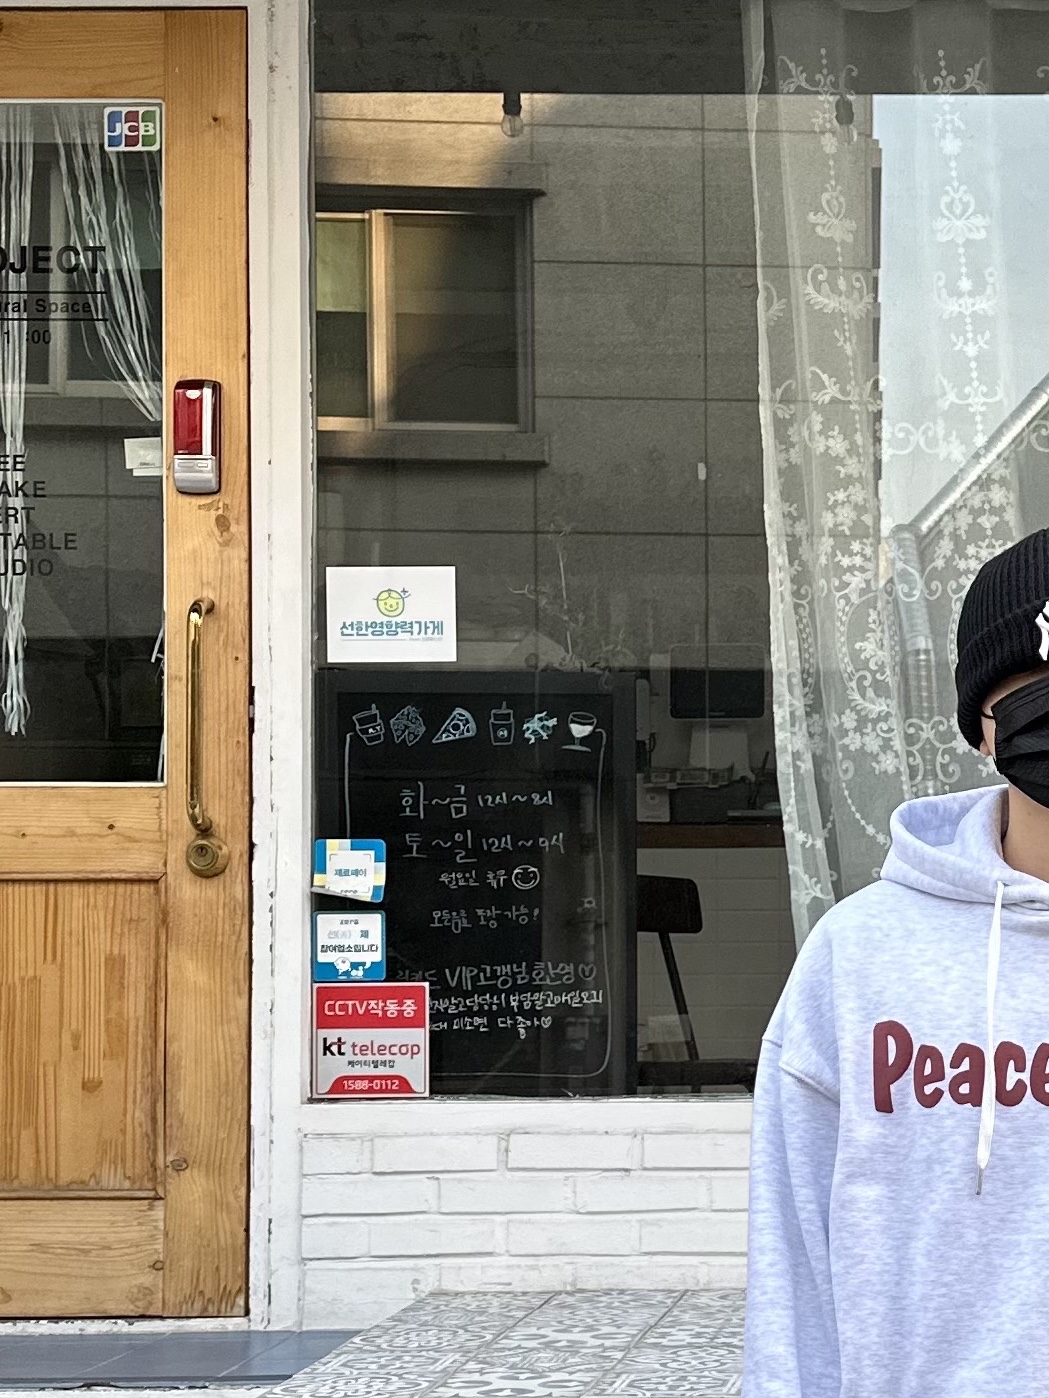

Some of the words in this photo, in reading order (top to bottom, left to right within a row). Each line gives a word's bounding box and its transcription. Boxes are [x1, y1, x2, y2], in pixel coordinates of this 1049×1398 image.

[107, 122, 156, 136] JCB
[35, 298, 92, 316] Space
[0, 480, 47, 498] AKE
[0, 506, 36, 524] RT
[0, 532, 78, 550] TABLE
[339, 620, 444, 637] 선한영향력가게
[324, 999, 418, 1018] CCTV작동중
[322, 1036, 347, 1057] kt
[350, 1039, 421, 1060] telecop
[342, 1080, 400, 1091] 1588-0112
